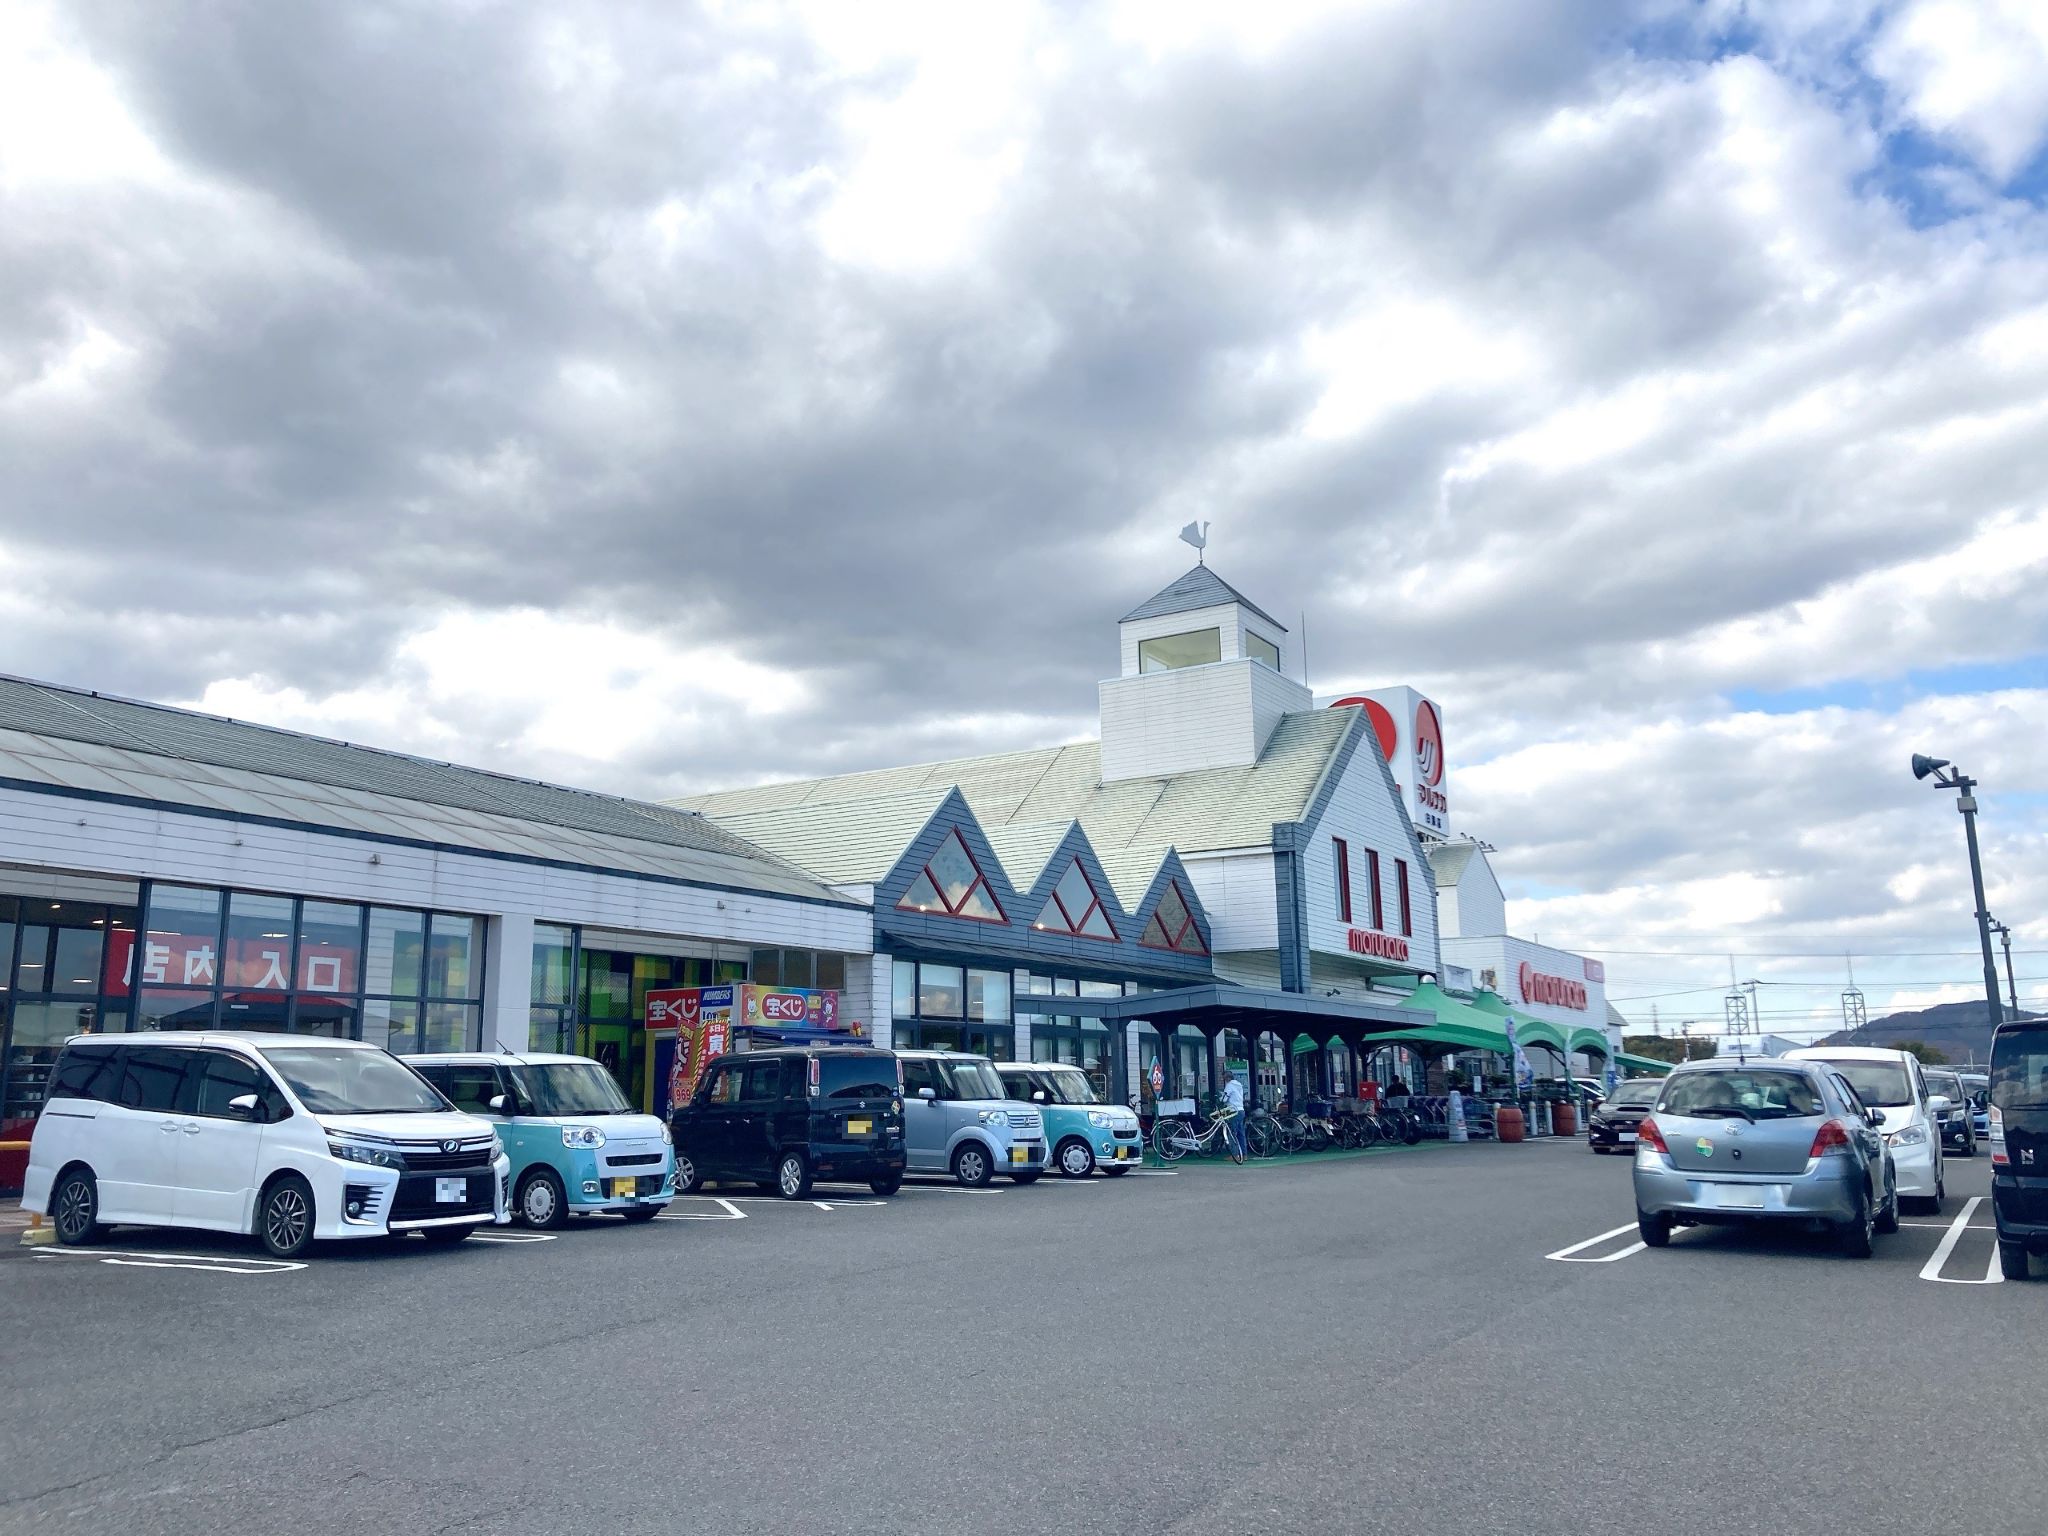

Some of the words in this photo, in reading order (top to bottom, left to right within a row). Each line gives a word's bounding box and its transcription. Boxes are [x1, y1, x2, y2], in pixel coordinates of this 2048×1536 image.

[1348, 928, 1408, 961] marunaka
[702, 990, 731, 1001] NUMBERS
[649, 998, 698, 1020] 宝くじ
[766, 998, 802, 1016] 宝くじ
